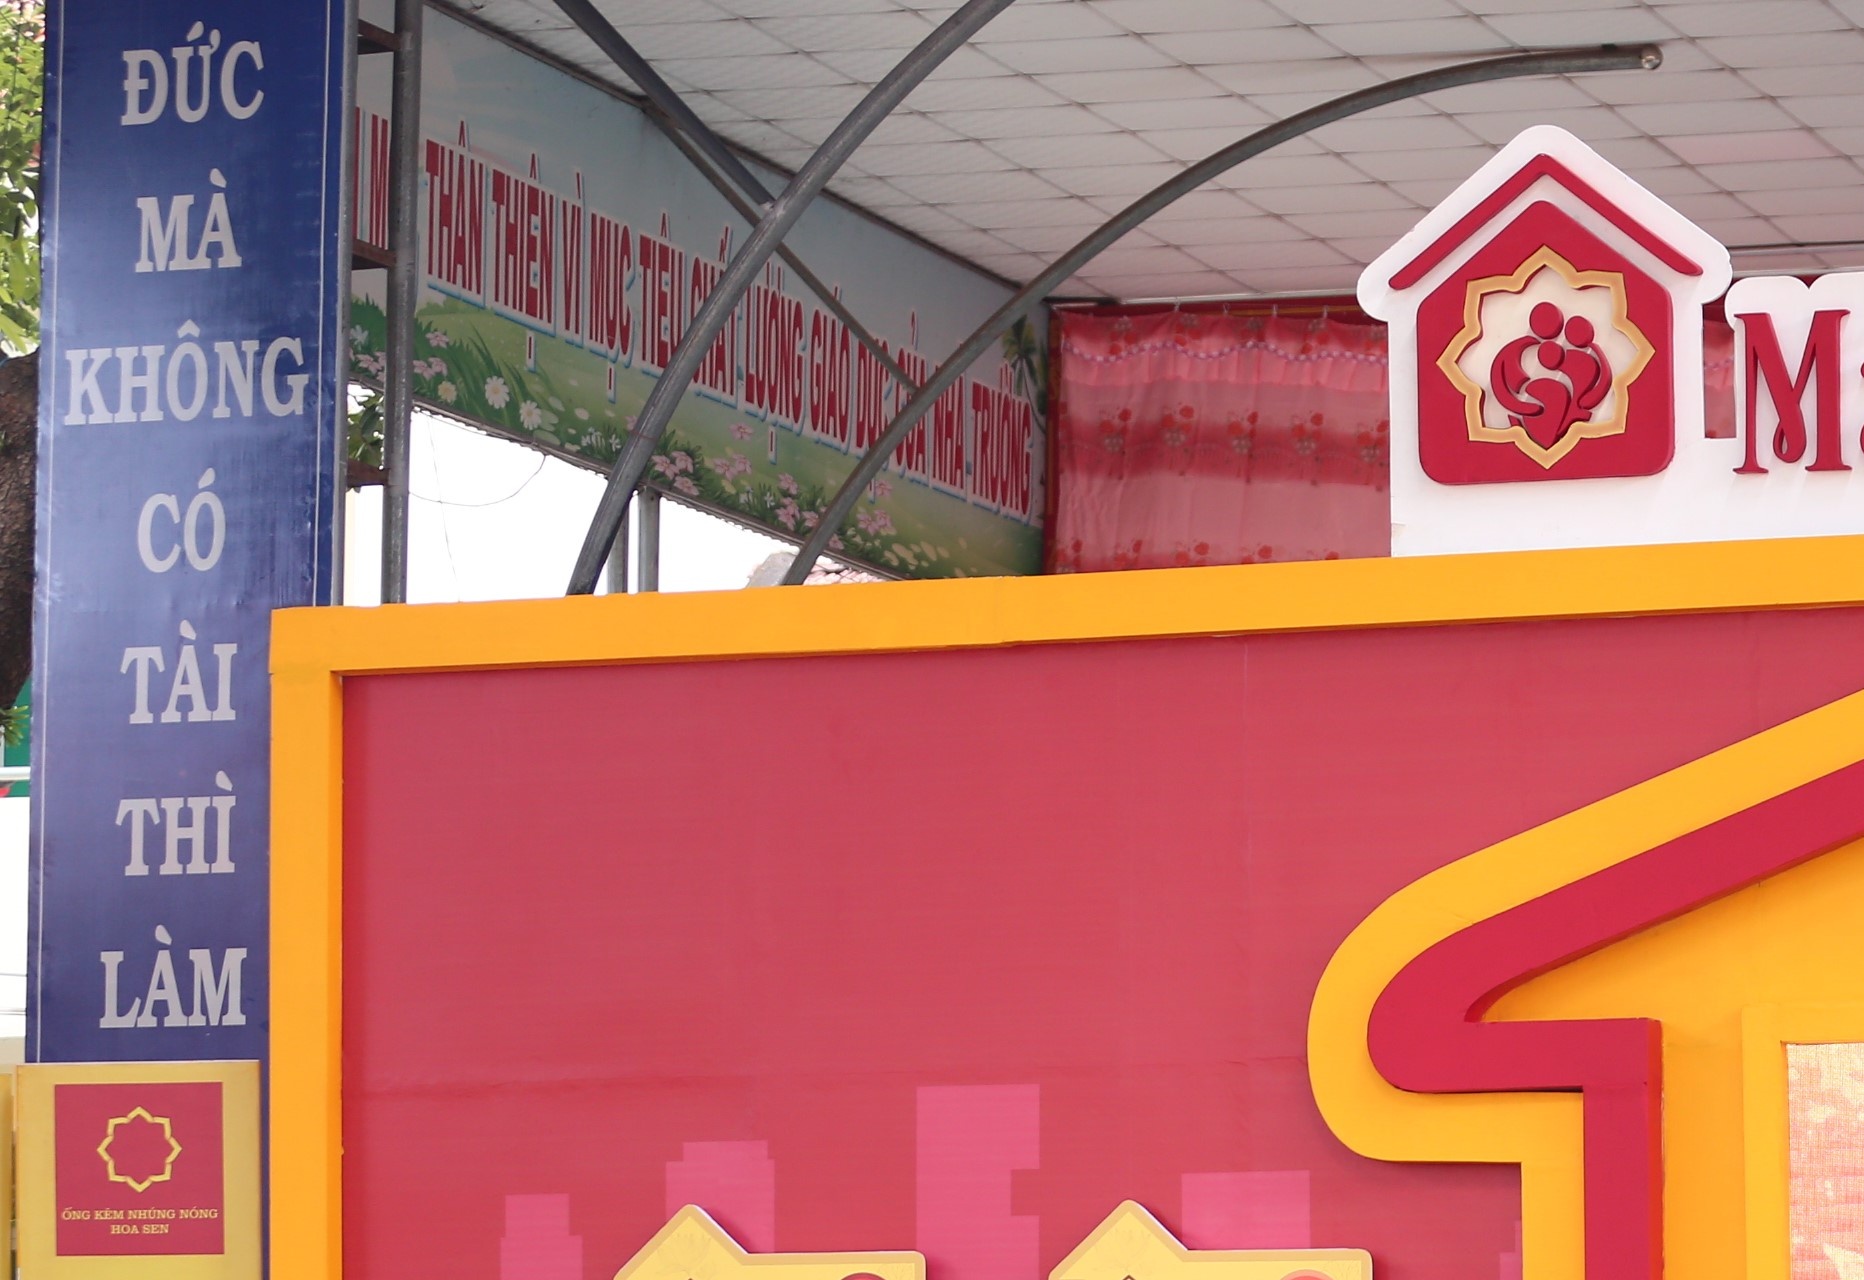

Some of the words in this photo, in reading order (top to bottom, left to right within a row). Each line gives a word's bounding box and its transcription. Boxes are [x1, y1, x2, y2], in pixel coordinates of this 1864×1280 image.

[120, 21, 264, 126] ĐỨC
[135, 168, 242, 273] MÀ
[426, 120, 483, 295] THÂN
[493, 153, 554, 359] THIỆN
[562, 172, 582, 334] VÌ
[590, 213, 632, 390] MỤC
[640, 212, 684, 370] TIÊU
[745, 262, 805, 452] LƯỢNG
[810, 286, 850, 443] GIÁO
[972, 362, 1032, 516] TRƯỜNG
[63, 319, 310, 427] KHÔNG
[137, 467, 226, 573] CÓ
[120, 619, 237, 724] TÀI
[115, 770, 236, 876] THÌ
[100, 924, 247, 1029] LÀM
[62, 1206, 91, 1221] ỐNG
[94, 1207, 124, 1220] KẼM
[128, 1206, 175, 1220] NHÚNG
[179, 1205, 218, 1219] NÓNG
[111, 1224, 140, 1235] HOA
[142, 1223, 169, 1235] SEN
